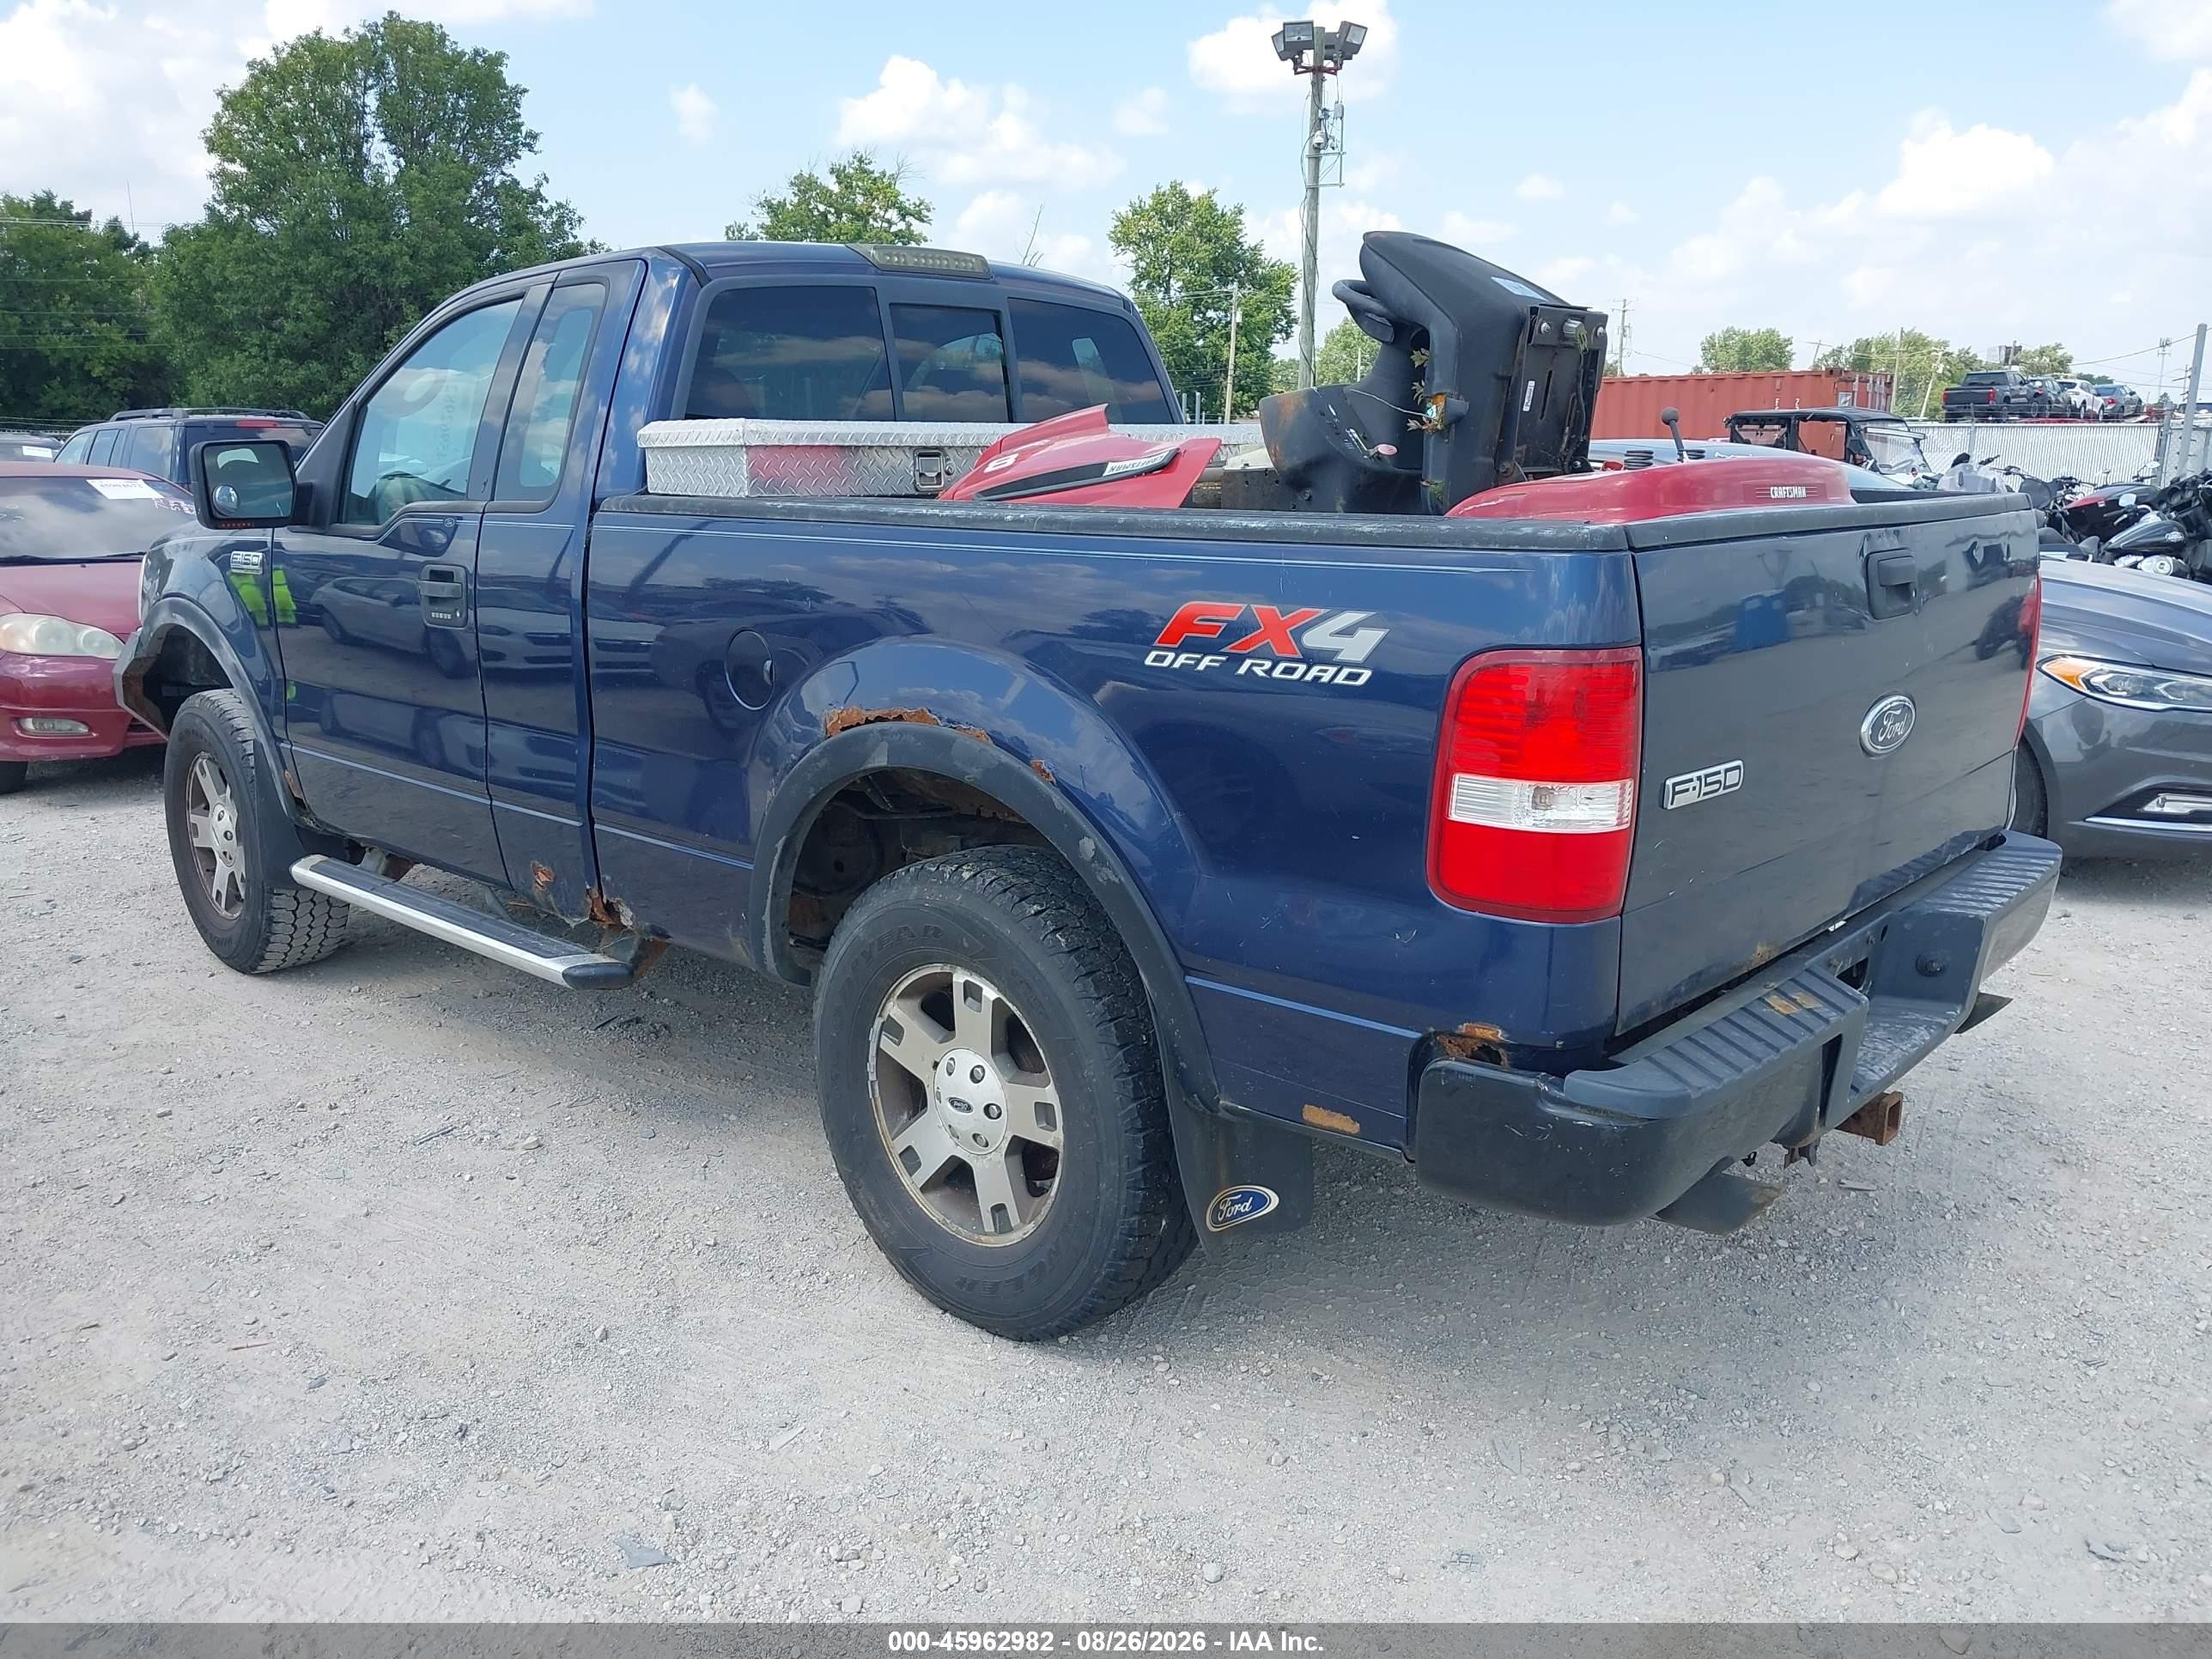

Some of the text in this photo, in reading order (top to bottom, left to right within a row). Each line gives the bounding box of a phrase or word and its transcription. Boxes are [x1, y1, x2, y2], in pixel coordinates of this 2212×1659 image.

[1770, 486, 1807, 498] CRAFTSMAN
[1152, 601, 1390, 664] FX4
[1144, 650, 1373, 687] OFF ROAD
[1878, 708, 1907, 742] Ford
[1217, 1194, 1254, 1222] Ford
